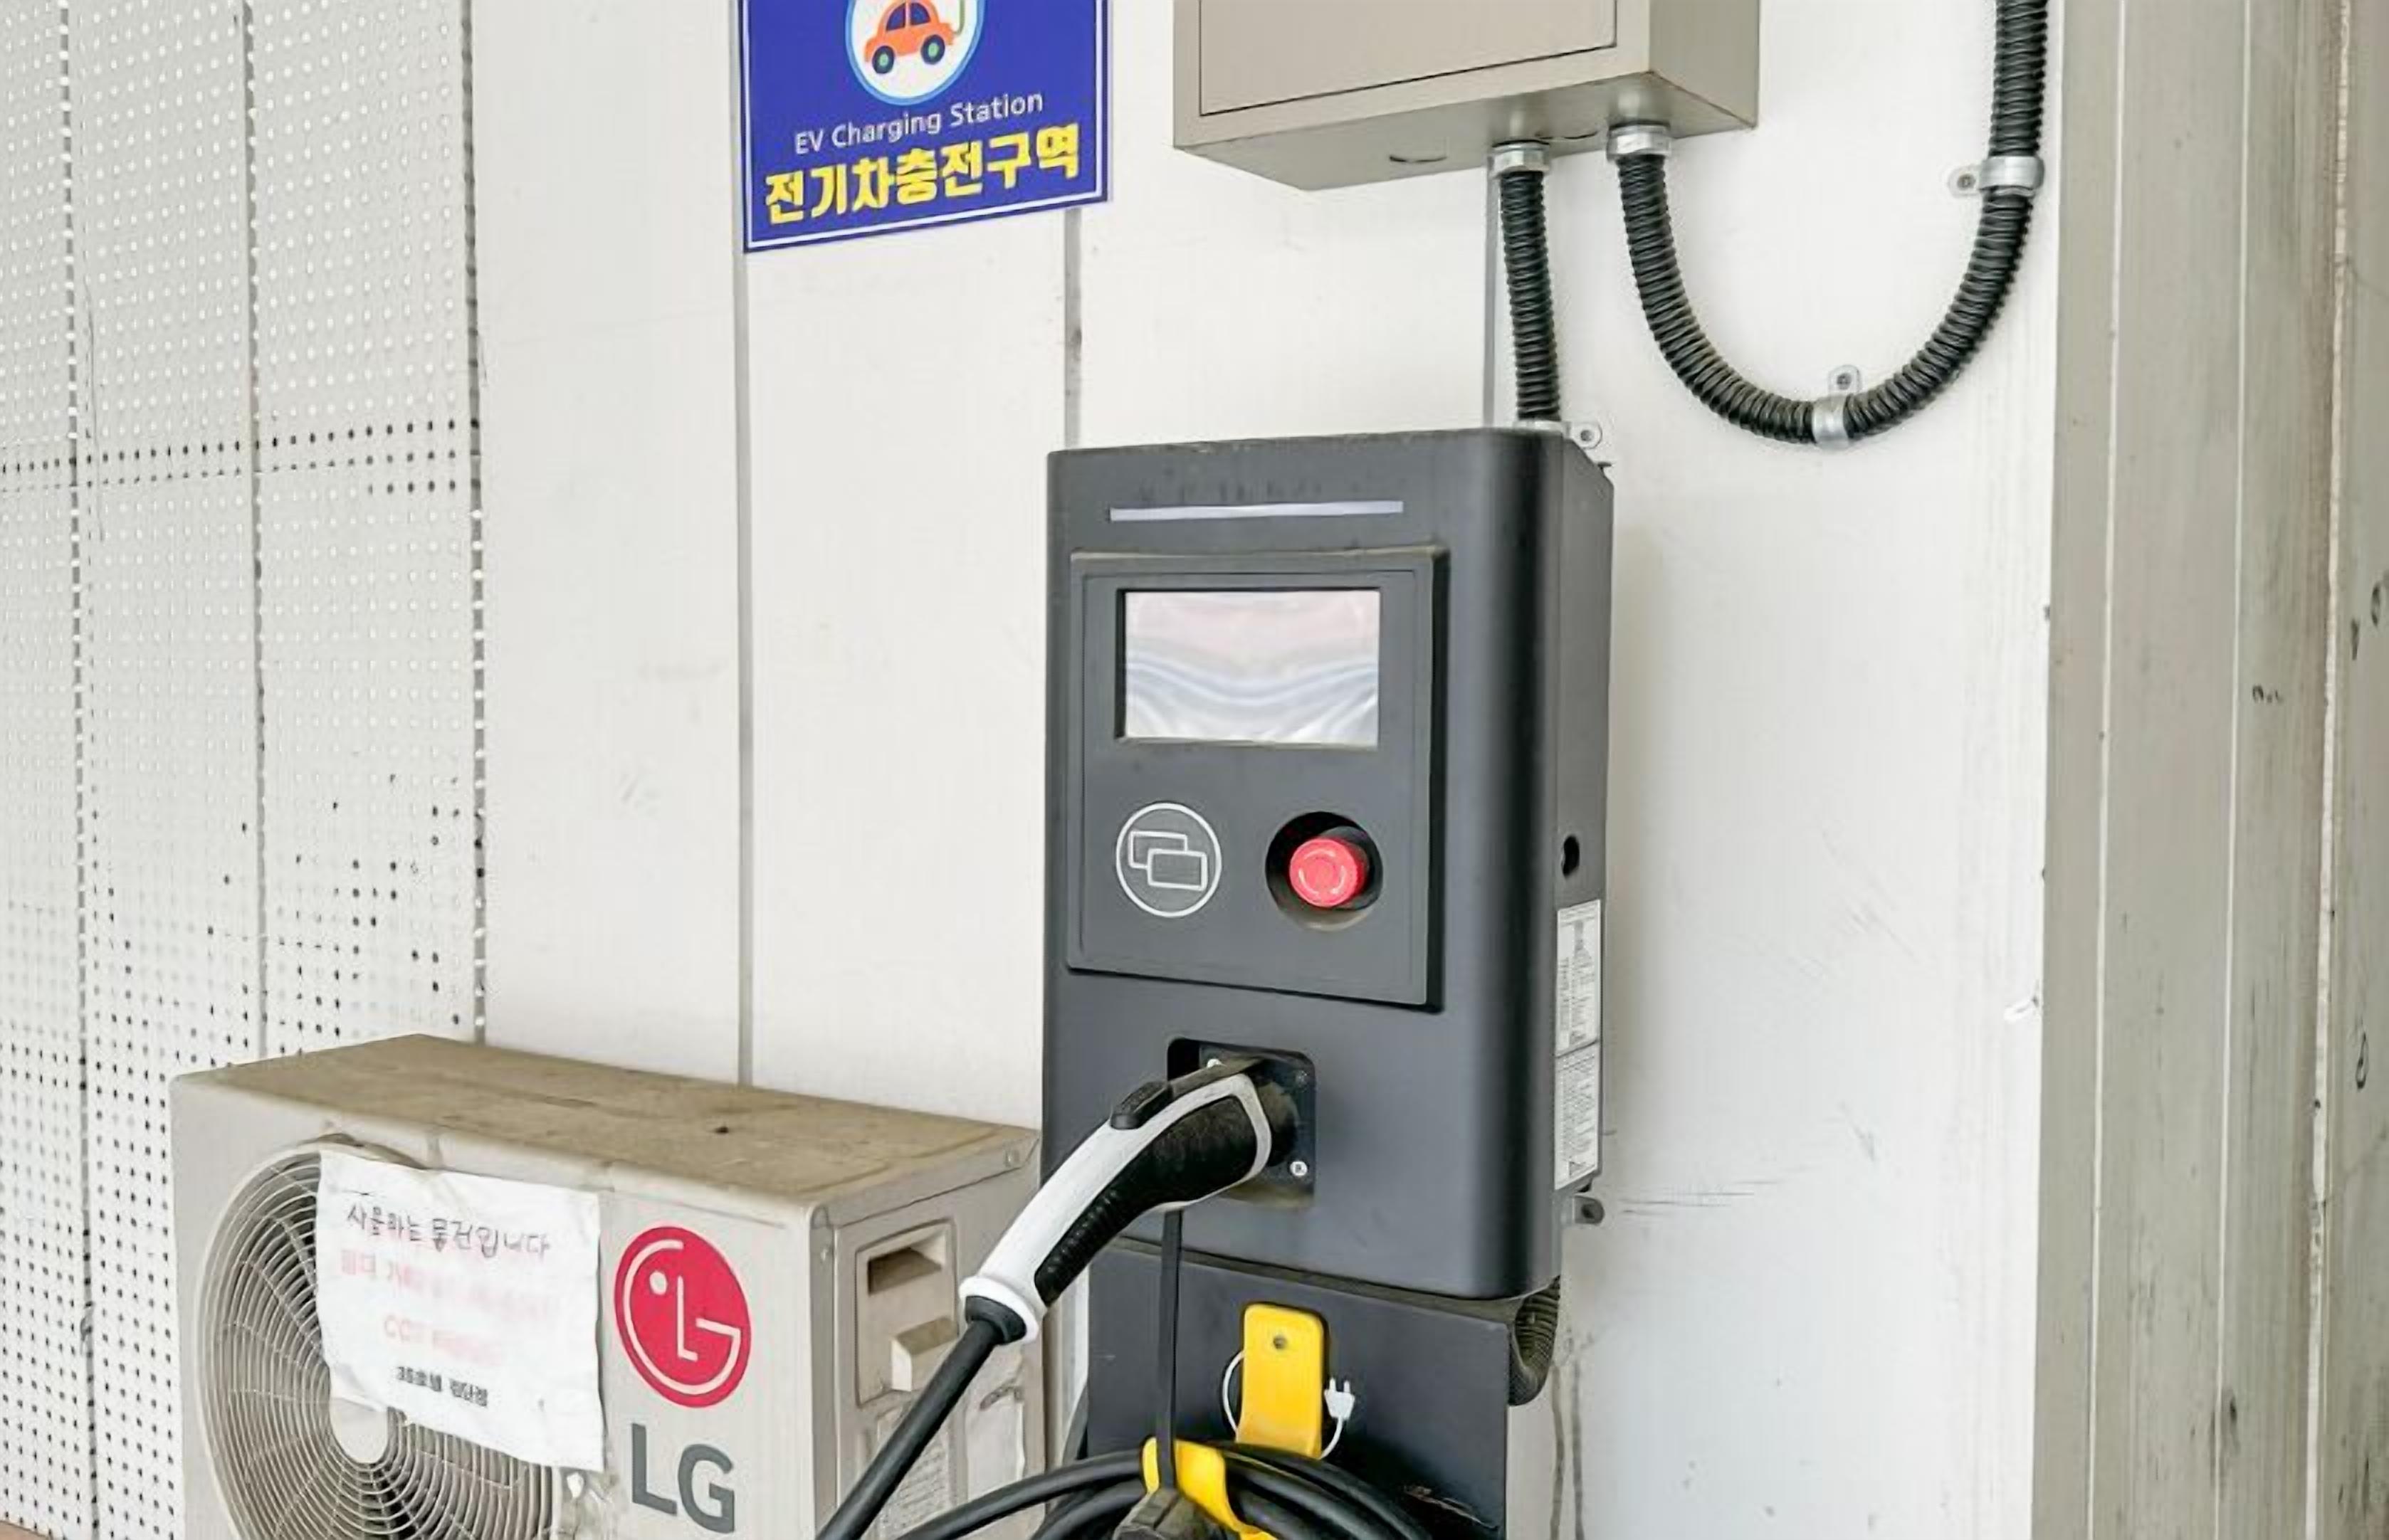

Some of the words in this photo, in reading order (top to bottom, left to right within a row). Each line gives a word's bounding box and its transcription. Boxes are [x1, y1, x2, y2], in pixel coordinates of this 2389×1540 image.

[765, 122, 1079, 225] 전기차충전구역
[795, 129, 824, 154] EV
[832, 111, 942, 147] Charging
[950, 93, 1043, 127] Station
[631, 1422, 735, 1534] LG
